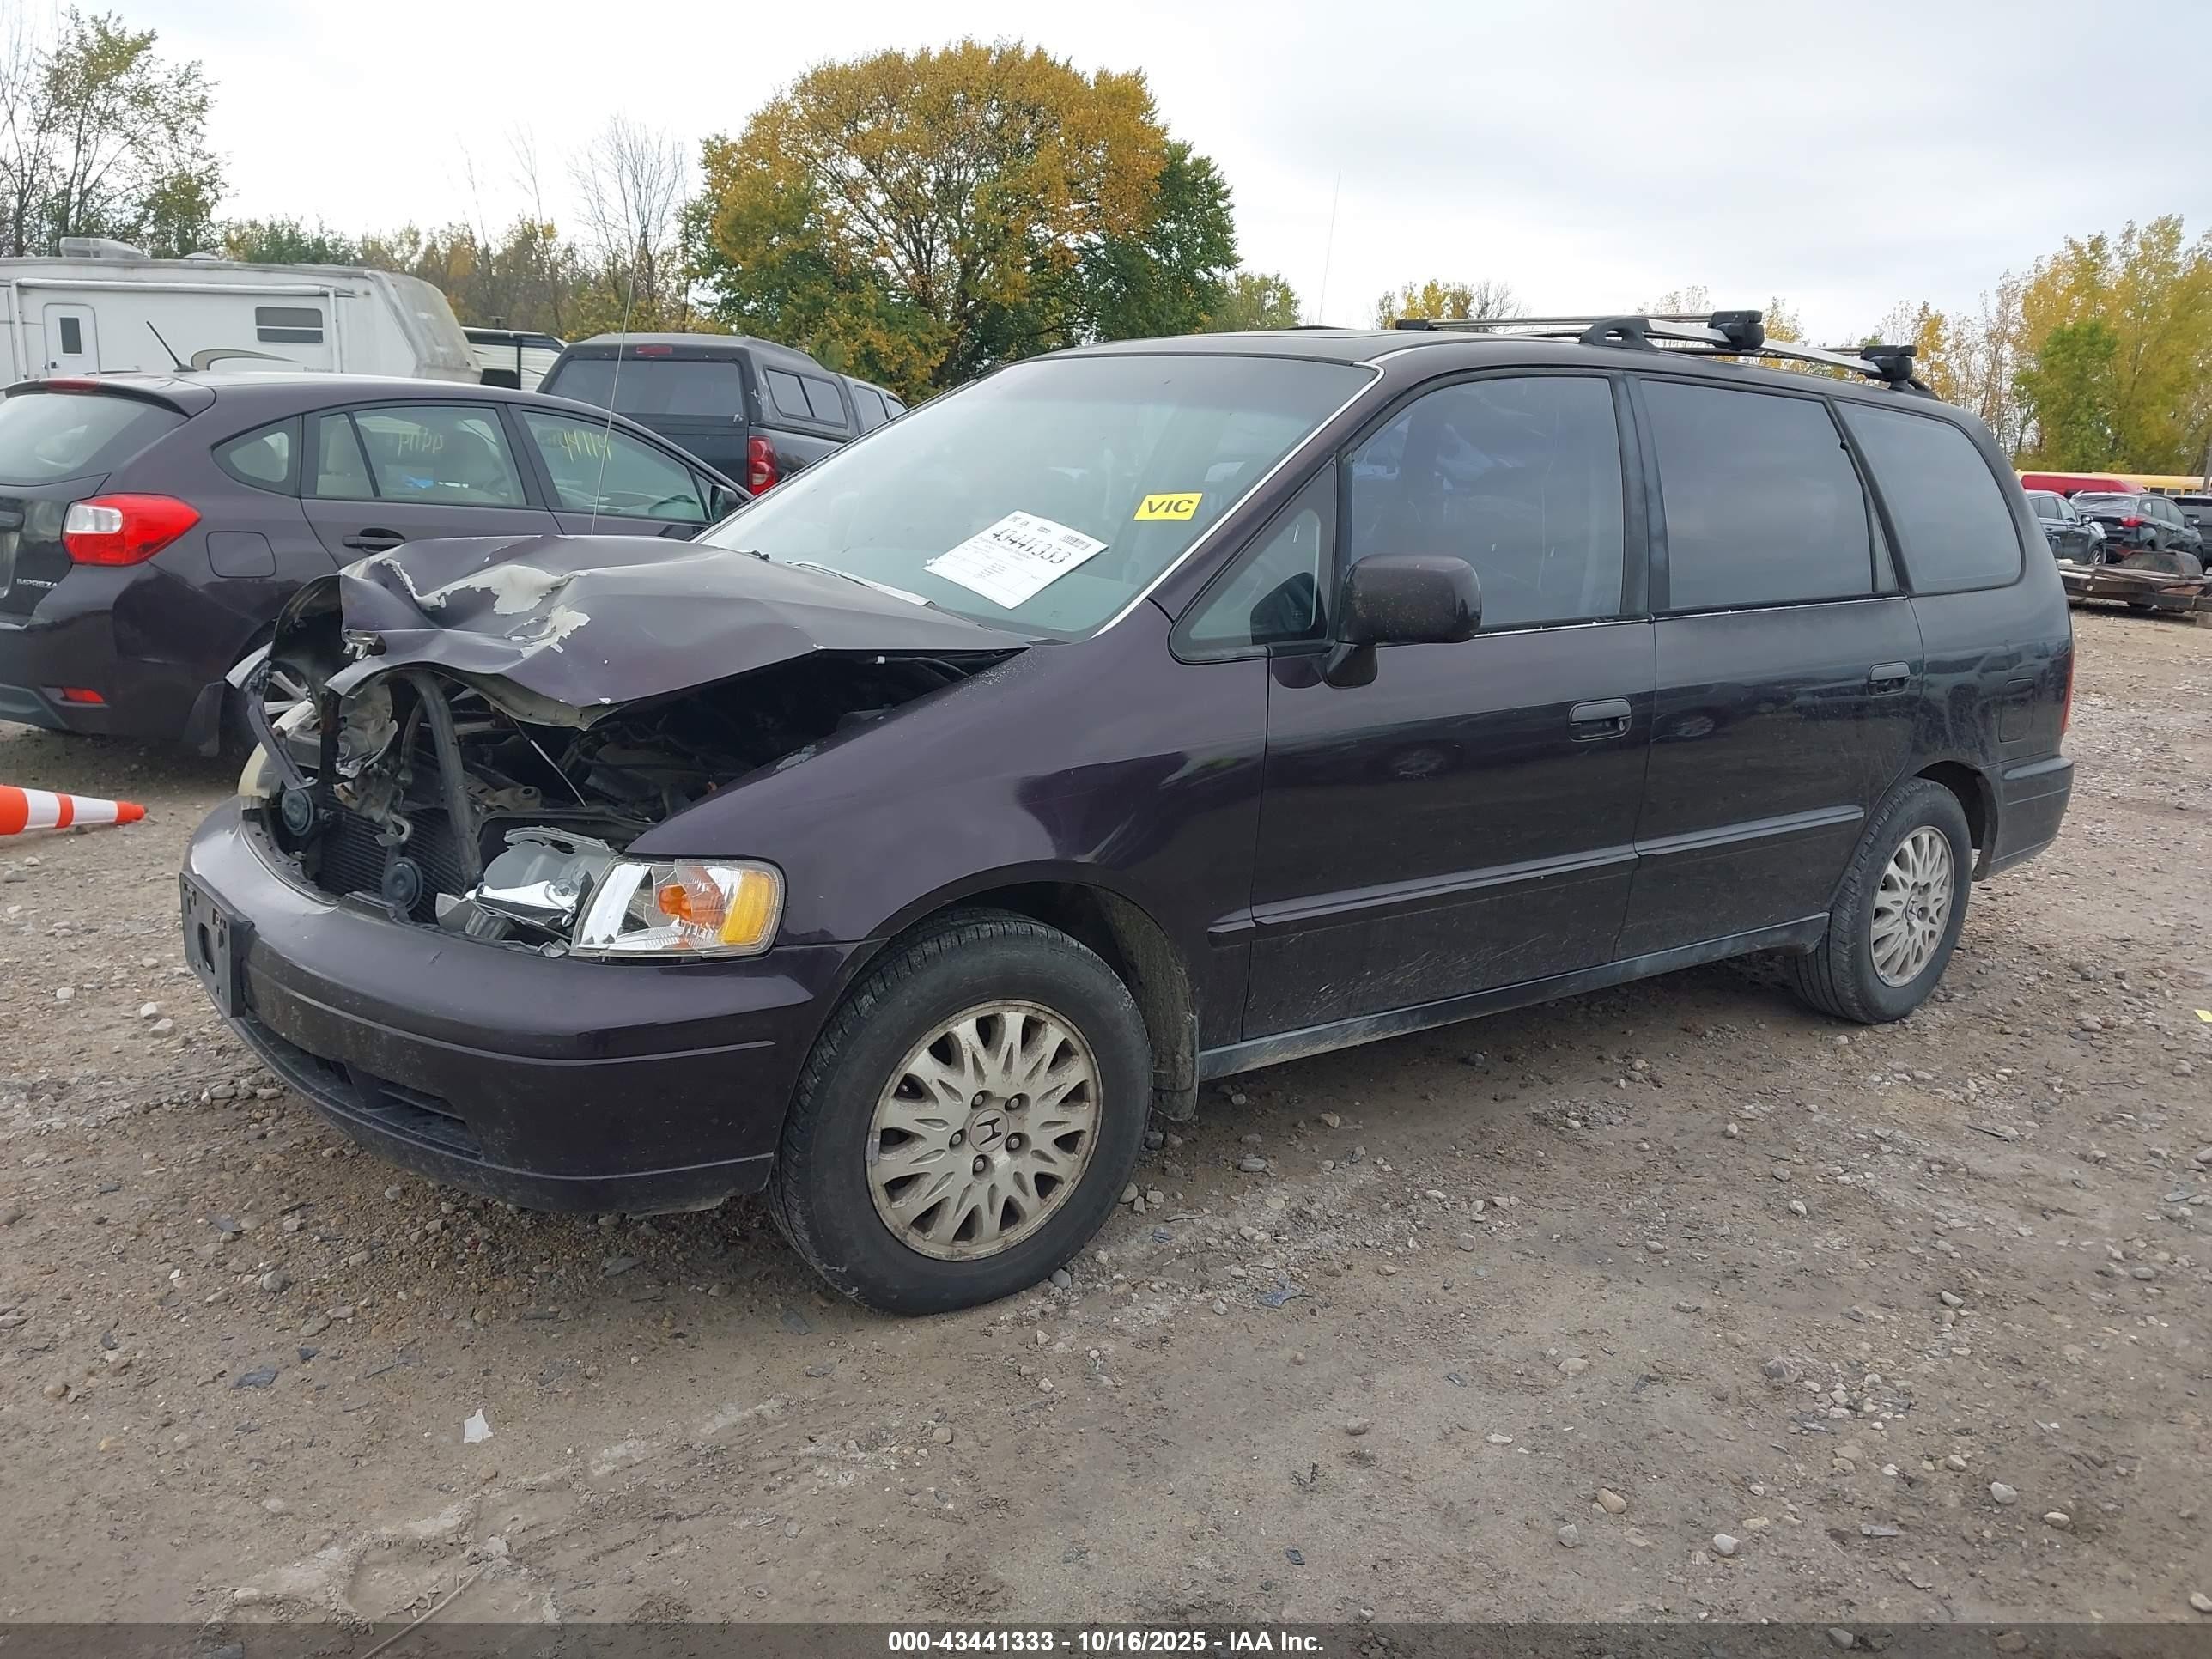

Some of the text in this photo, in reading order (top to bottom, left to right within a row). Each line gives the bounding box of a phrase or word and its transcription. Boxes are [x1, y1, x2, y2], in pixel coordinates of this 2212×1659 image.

[1147, 499, 1194, 514] VIC
[991, 528, 1073, 565] 43441333
[16, 578, 58, 589] IMPREZA
